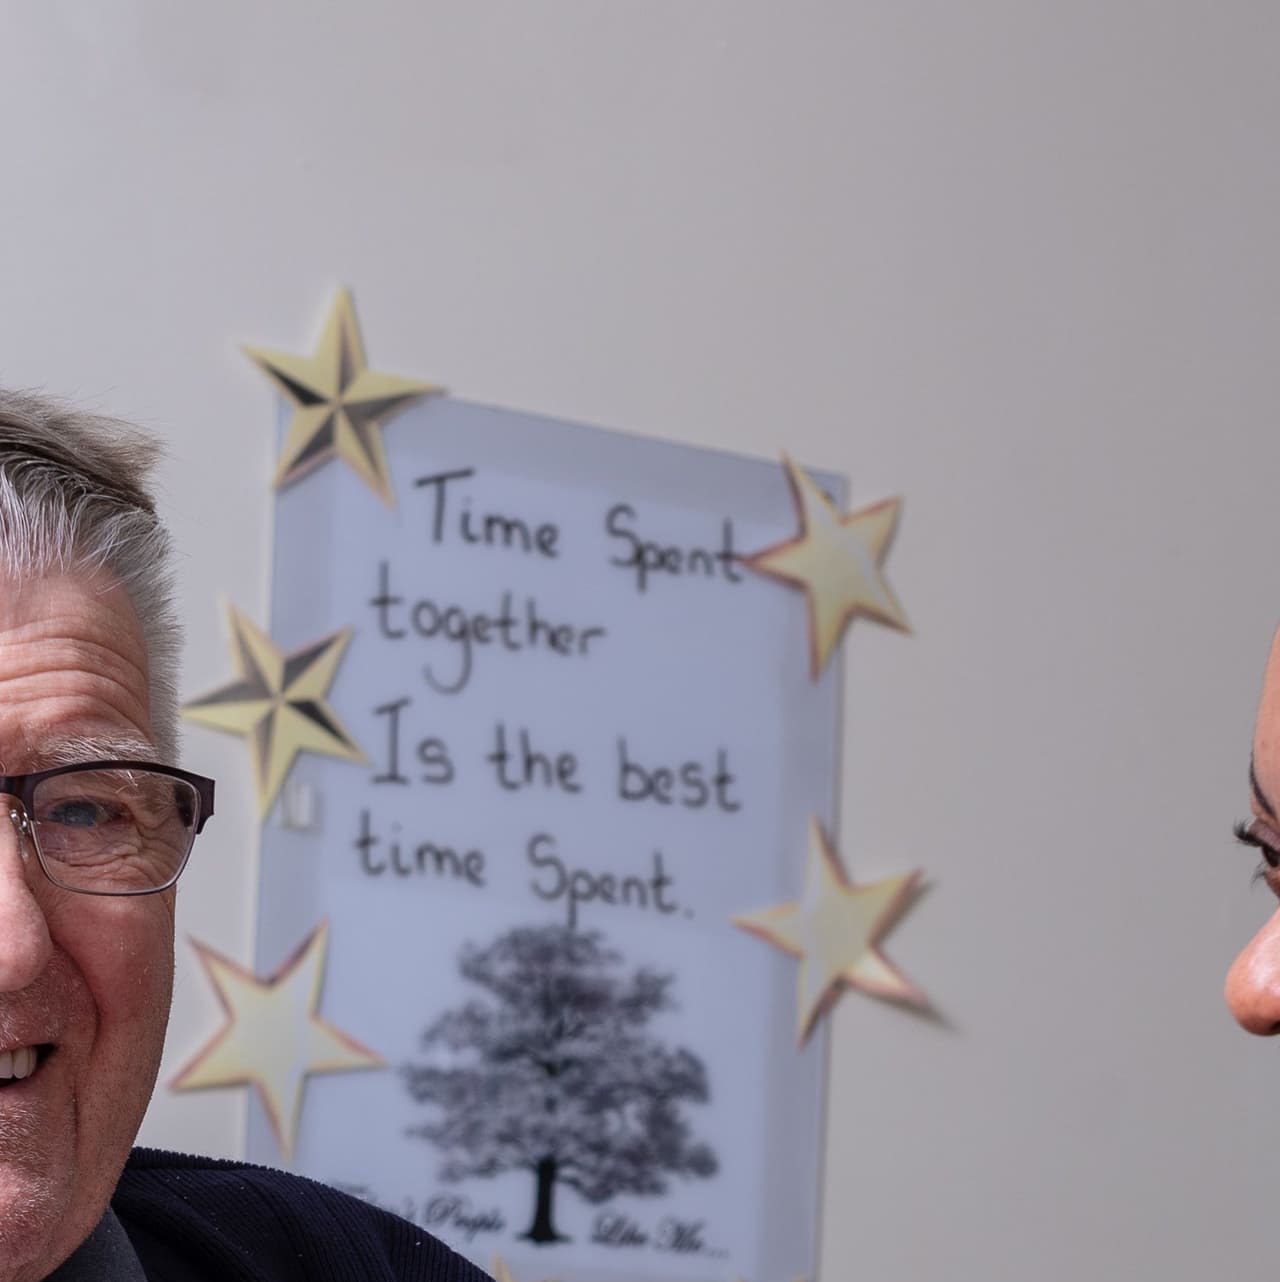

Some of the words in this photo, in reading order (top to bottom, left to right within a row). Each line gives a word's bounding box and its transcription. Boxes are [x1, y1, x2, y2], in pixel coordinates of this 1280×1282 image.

[413, 467, 560, 560] Time
[605, 502, 745, 594] Spent
[369, 560, 607, 695] together
[370, 697, 456, 787] Is
[486, 720, 583, 793] the
[617, 735, 743, 813] best
[354, 807, 487, 889] time
[527, 832, 696, 929] Spent.
